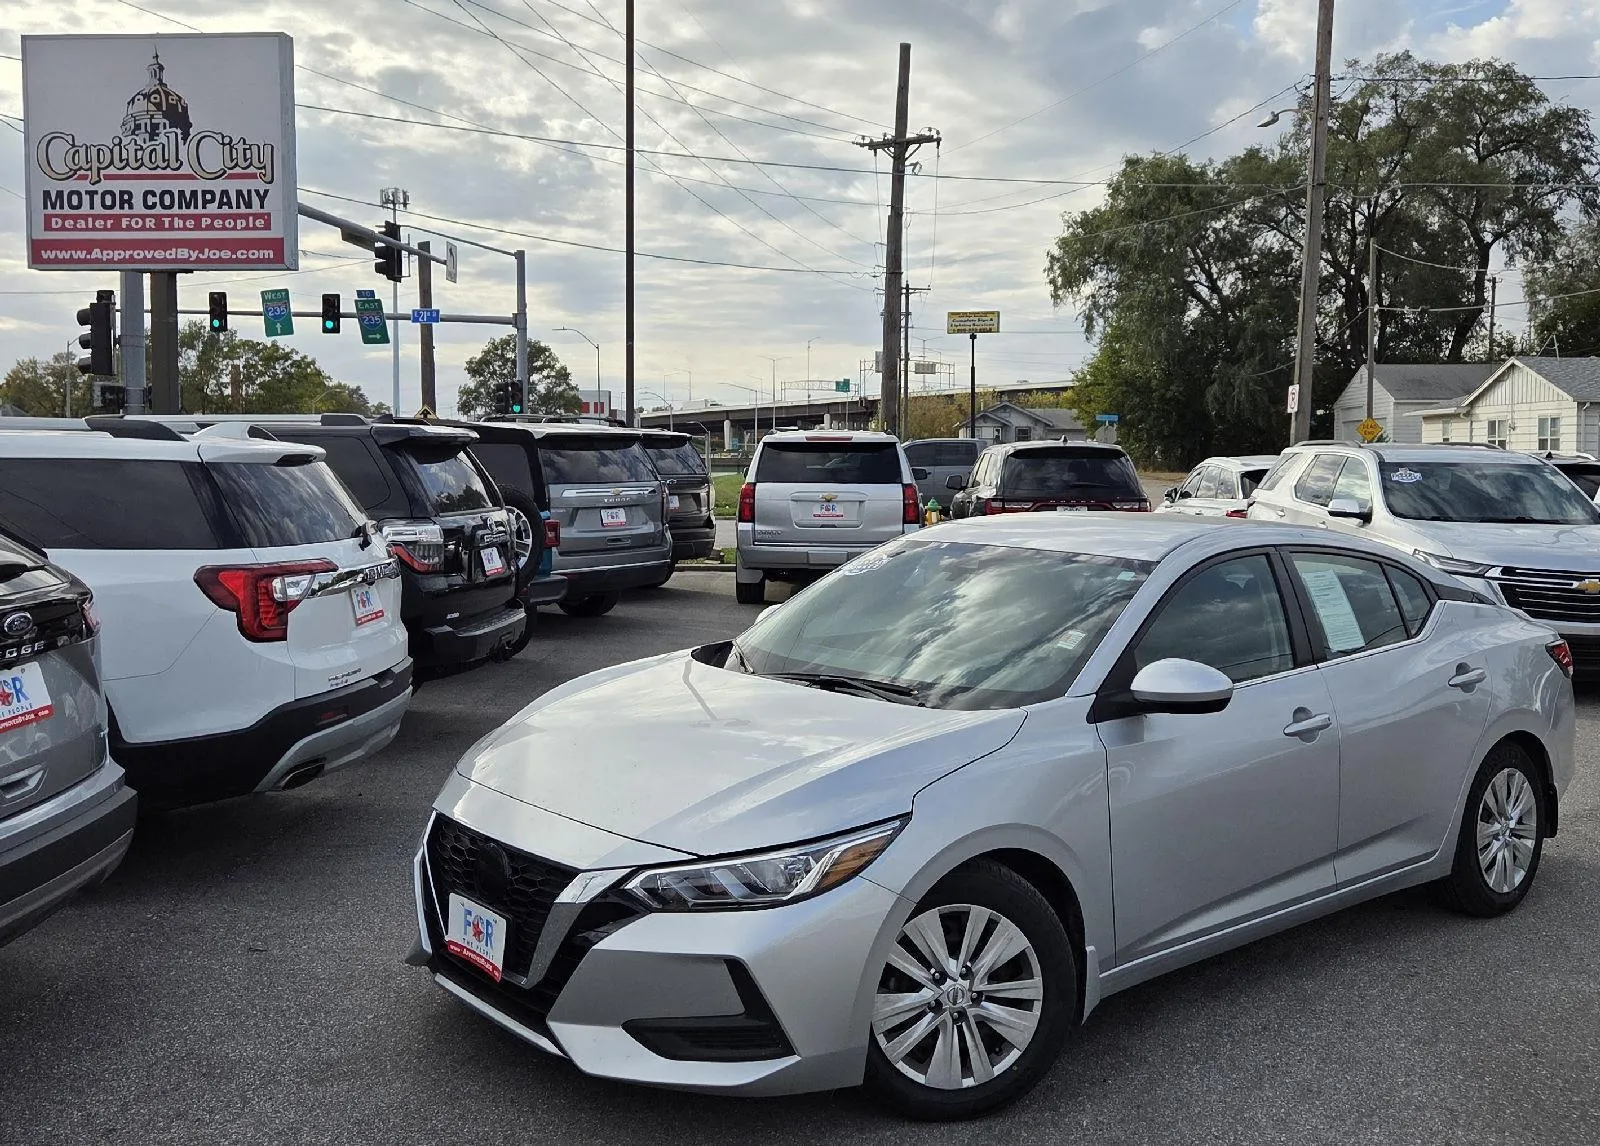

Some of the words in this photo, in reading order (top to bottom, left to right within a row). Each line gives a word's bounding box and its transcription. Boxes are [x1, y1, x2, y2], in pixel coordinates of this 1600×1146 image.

[36, 129, 183, 185] Capital
[188, 129, 275, 185] City
[43, 189, 134, 210] MOTOR
[142, 188, 270, 210] COMPANY
[51, 217, 112, 229] Dealer
[121, 217, 156, 229] FOR
[162, 217, 194, 229] The
[201, 216, 265, 229] People
[41, 248, 274, 262] www.ApprovedByJoe.com
[267, 305, 287, 316] 235
[363, 315, 381, 325] 235
[819, 503, 837, 512] FOR
[463, 908, 494, 949] FOR
[462, 937, 474, 948] THE
